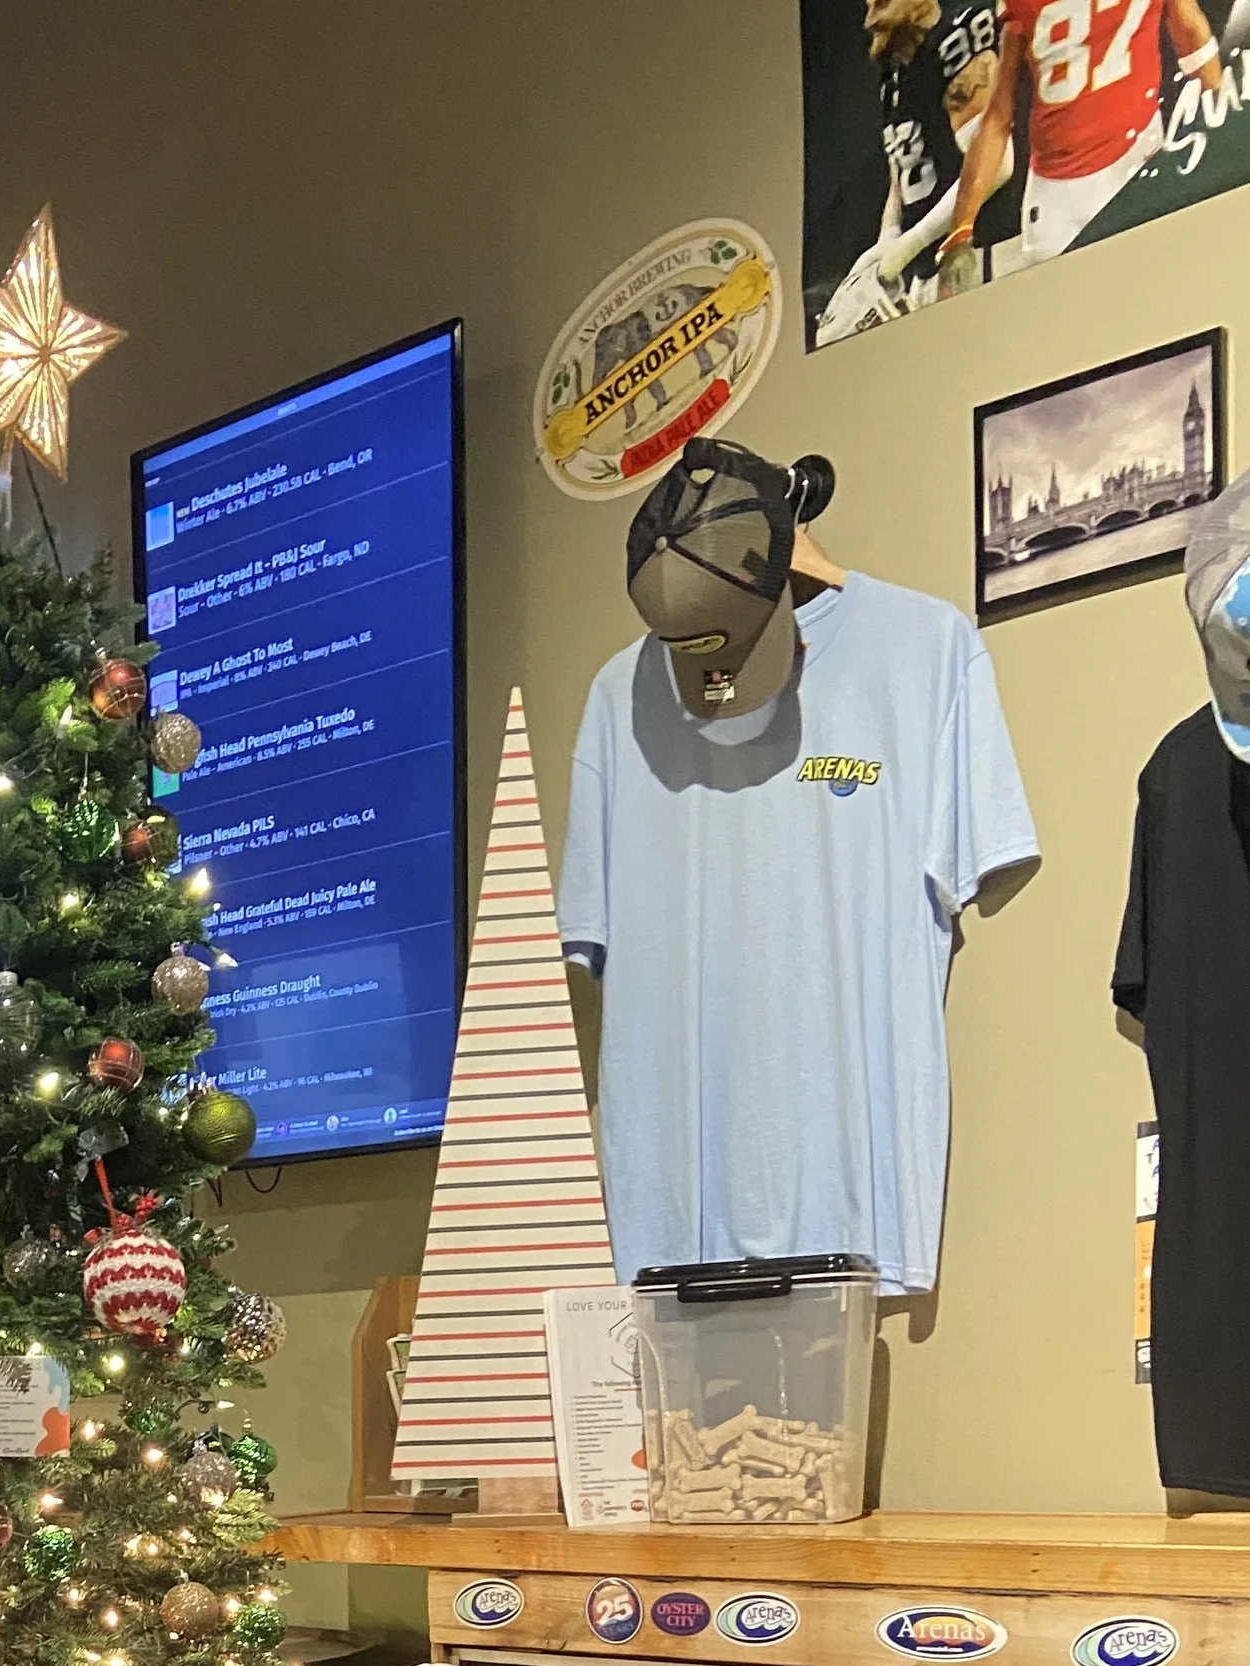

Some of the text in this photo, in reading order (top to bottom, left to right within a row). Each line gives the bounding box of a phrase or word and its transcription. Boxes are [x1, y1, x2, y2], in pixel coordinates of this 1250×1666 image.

[938, 8, 995, 77] 98
[1033, 0, 1146, 104] 87
[579, 289, 627, 344] ANCHOR
[585, 302, 724, 425] ANCHOR IPA
[303, 469, 322, 485] CAL
[191, 481, 243, 511] Deschutes
[217, 563, 252, 589] Spread
[271, 548, 298, 568] PB&J
[300, 539, 326, 559] Sour
[298, 560, 316, 576] CAL
[180, 638, 293, 686] Dewey A Ghost To Most
[219, 707, 355, 758] Head Pennsylvania Tuxedo
[796, 757, 882, 785] ARENAS
[183, 815, 275, 851] Sierra Nevada PILS
[310, 820, 327, 835] CAL
[362, 808, 376, 822] CA
[220, 906, 244, 924] Head
[246, 898, 283, 918] Grateful
[285, 892, 309, 910] Dead
[311, 888, 335, 907] Juicy
[336, 883, 358, 900] Pale
[359, 879, 376, 894] Ale
[233, 974, 321, 1003] Guinness Draught
[218, 1071, 246, 1086] Miller
[248, 1066, 267, 1082] Lite
[566, 1301, 627, 1311] LOVE YOUR
[596, 1594, 633, 1626] 25
[657, 1603, 704, 1615] OYSTER
[666, 1615, 696, 1626] CITY
[897, 1614, 986, 1641] Arenas
